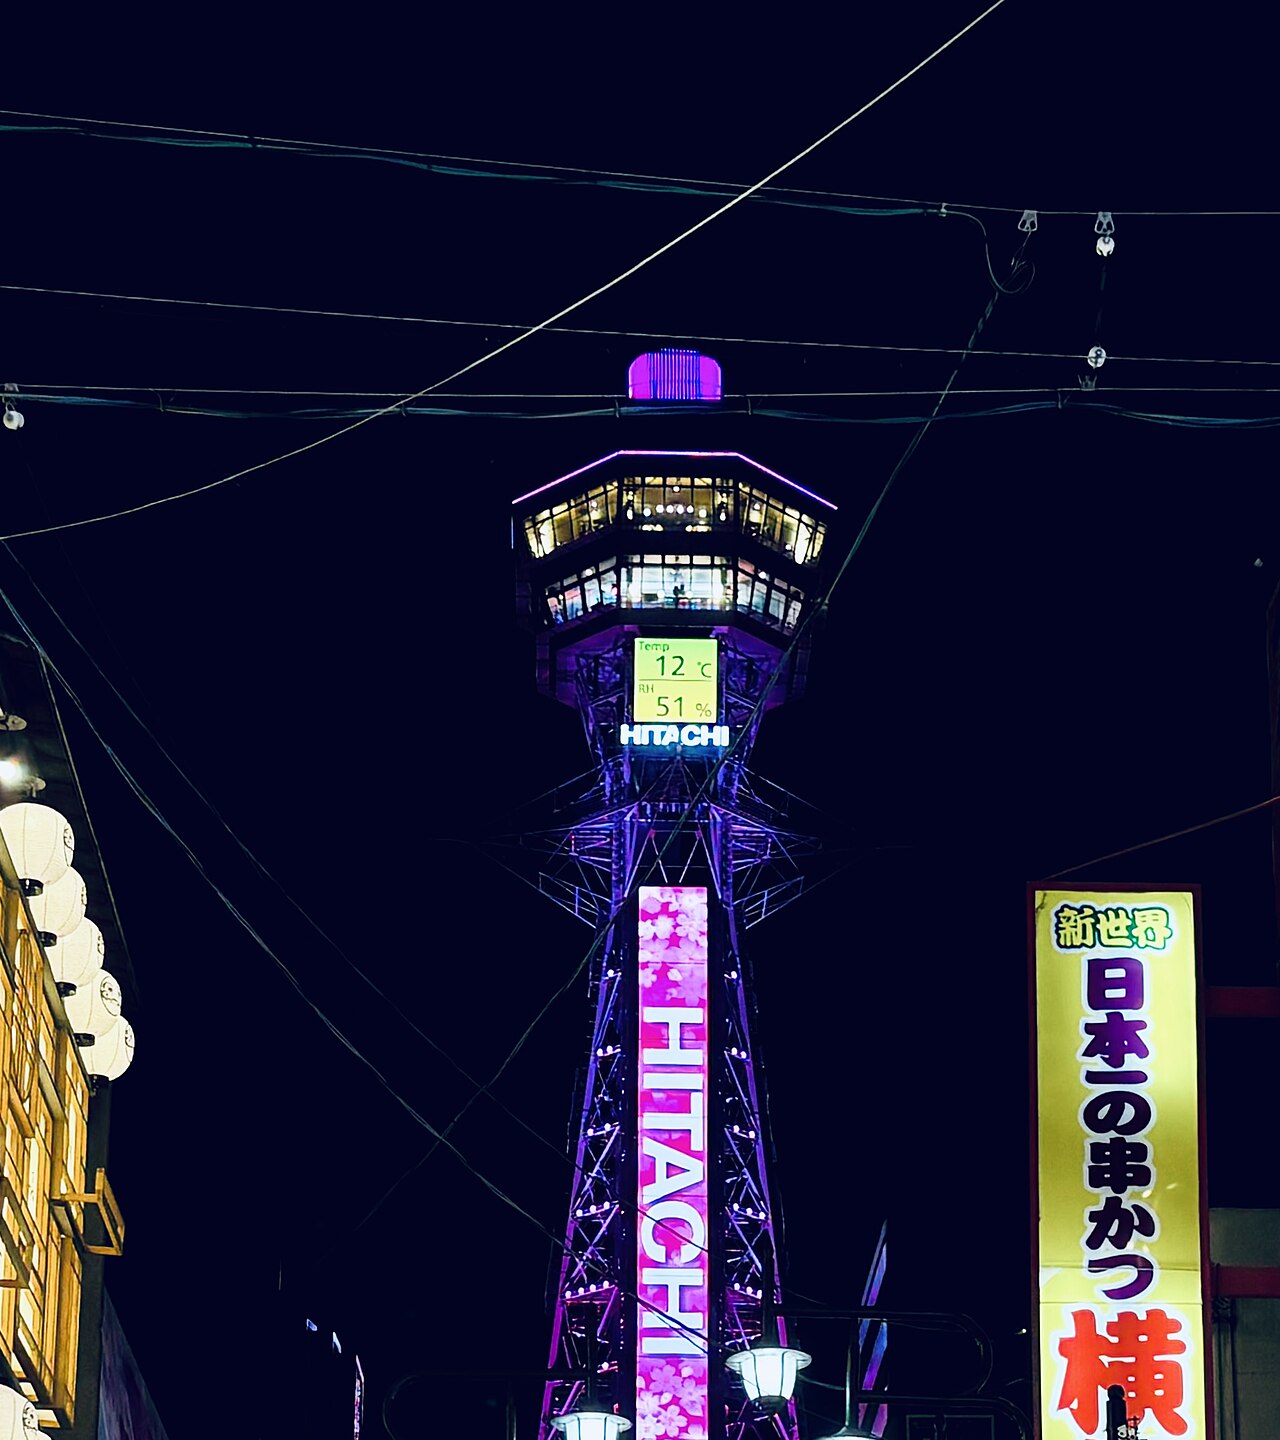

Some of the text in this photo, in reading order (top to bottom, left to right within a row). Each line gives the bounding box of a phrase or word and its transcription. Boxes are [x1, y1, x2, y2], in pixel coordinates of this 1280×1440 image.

[639, 641, 670, 652] Temp
[655, 655, 686, 676] 12
[638, 683, 654, 694] RH
[656, 696, 713, 718] 51 %
[620, 723, 730, 747] HITACHI
[1053, 904, 1175, 952] 新世界
[1081, 956, 1158, 1301] 日本一の串かつ
[641, 1007, 705, 1357] HITACHI
